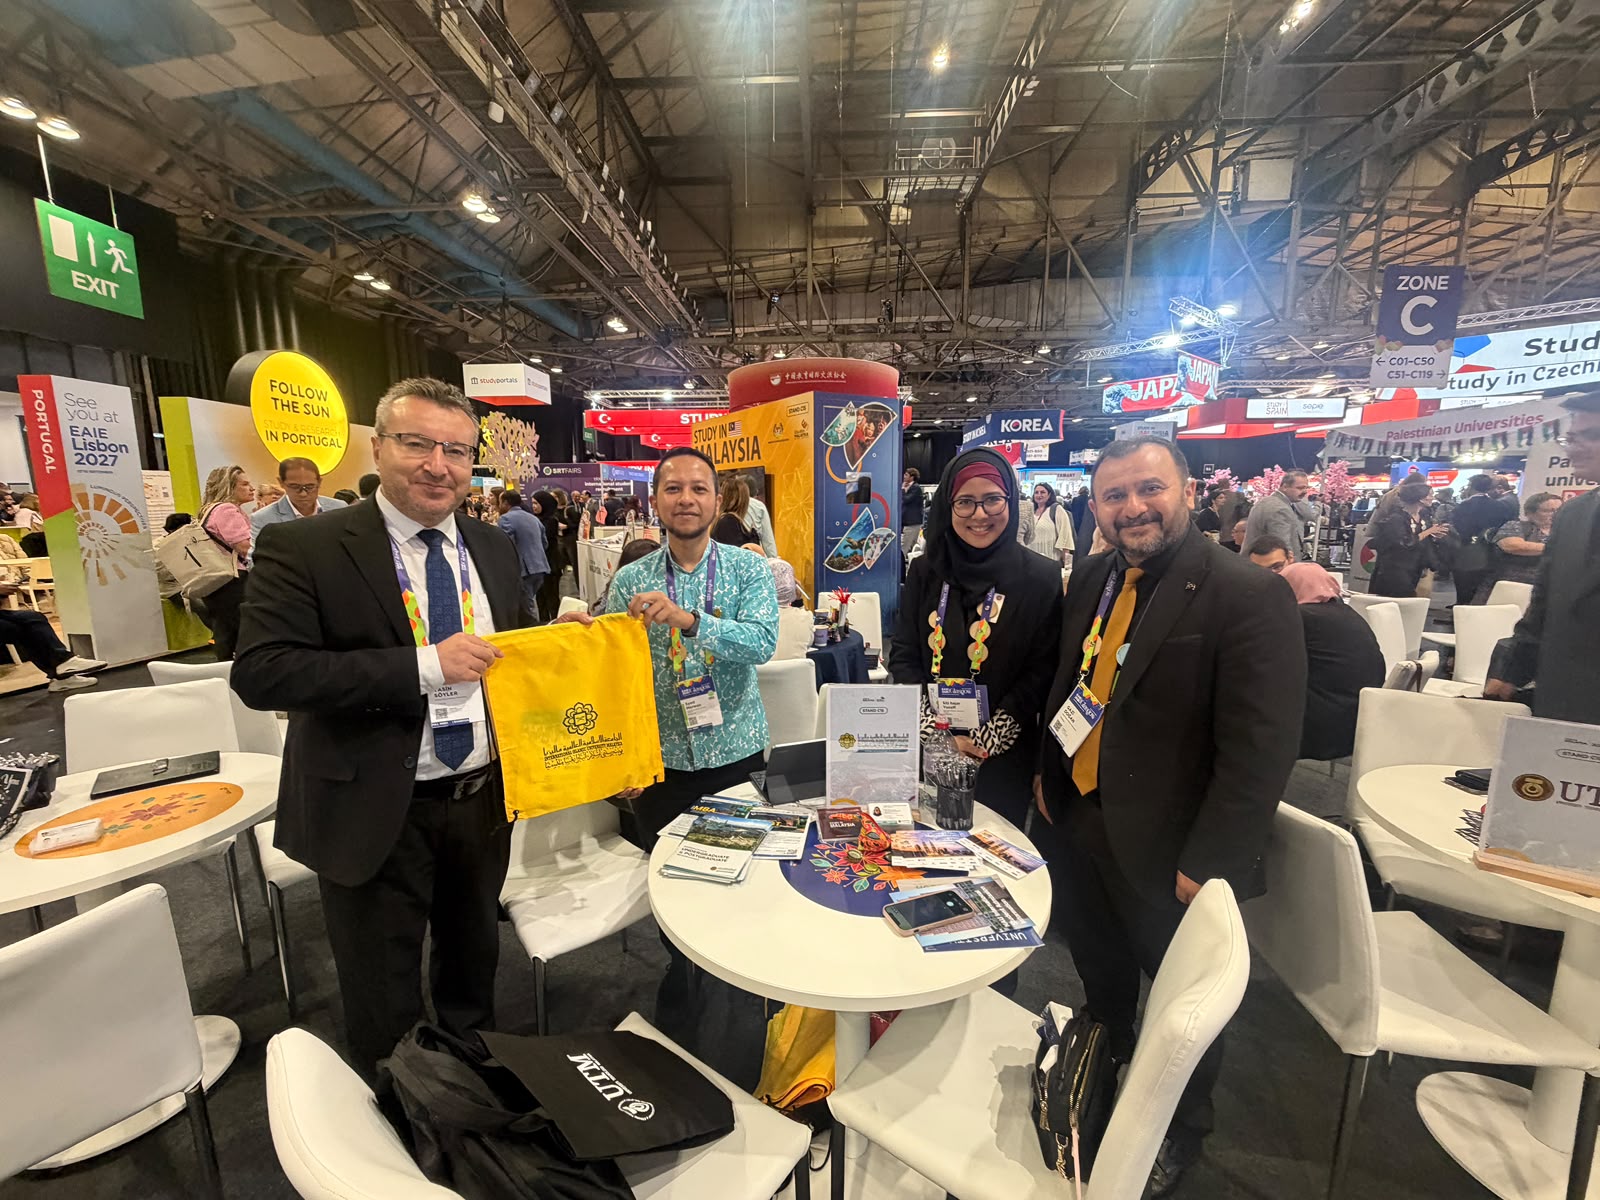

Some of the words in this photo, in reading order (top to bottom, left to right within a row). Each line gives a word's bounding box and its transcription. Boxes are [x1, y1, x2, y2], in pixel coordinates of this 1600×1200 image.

[71, 270, 120, 299] EXIT
[1396, 275, 1450, 291] ZONE
[1400, 295, 1438, 336] C
[1523, 330, 1600, 357] Stud
[1389, 357, 1435, 366] C01-C50
[1189, 359, 1220, 388] JAPAN
[1387, 369, 1433, 379] C51-C119
[1447, 373, 1501, 391] tudy
[1506, 370, 1526, 385] in
[269, 379, 328, 402] FOLLOW
[64, 393, 97, 409] See
[271, 397, 300, 413] THE
[303, 403, 330, 418] SUN
[65, 408, 99, 421] you
[104, 411, 119, 423] at
[32, 389, 57, 475] PORTUGAL
[69, 425, 109, 439] EAIE
[263, 420, 290, 431] STUDY
[694, 425, 718, 444] STUDY
[719, 423, 727, 438] IN
[1001, 418, 1053, 433] KOREA
[1386, 425, 1451, 441] Palestinian
[1454, 413, 1544, 434] Universities
[72, 438, 129, 453] Lisbon
[265, 430, 279, 441] IN
[282, 432, 342, 448] PORTUGAL
[74, 453, 118, 467] 2027
[1548, 456, 1570, 469] Pa
[1545, 473, 1600, 486] unive
[955, 931, 1028, 945] UNIVERS
[567, 1053, 625, 1102] UTM
